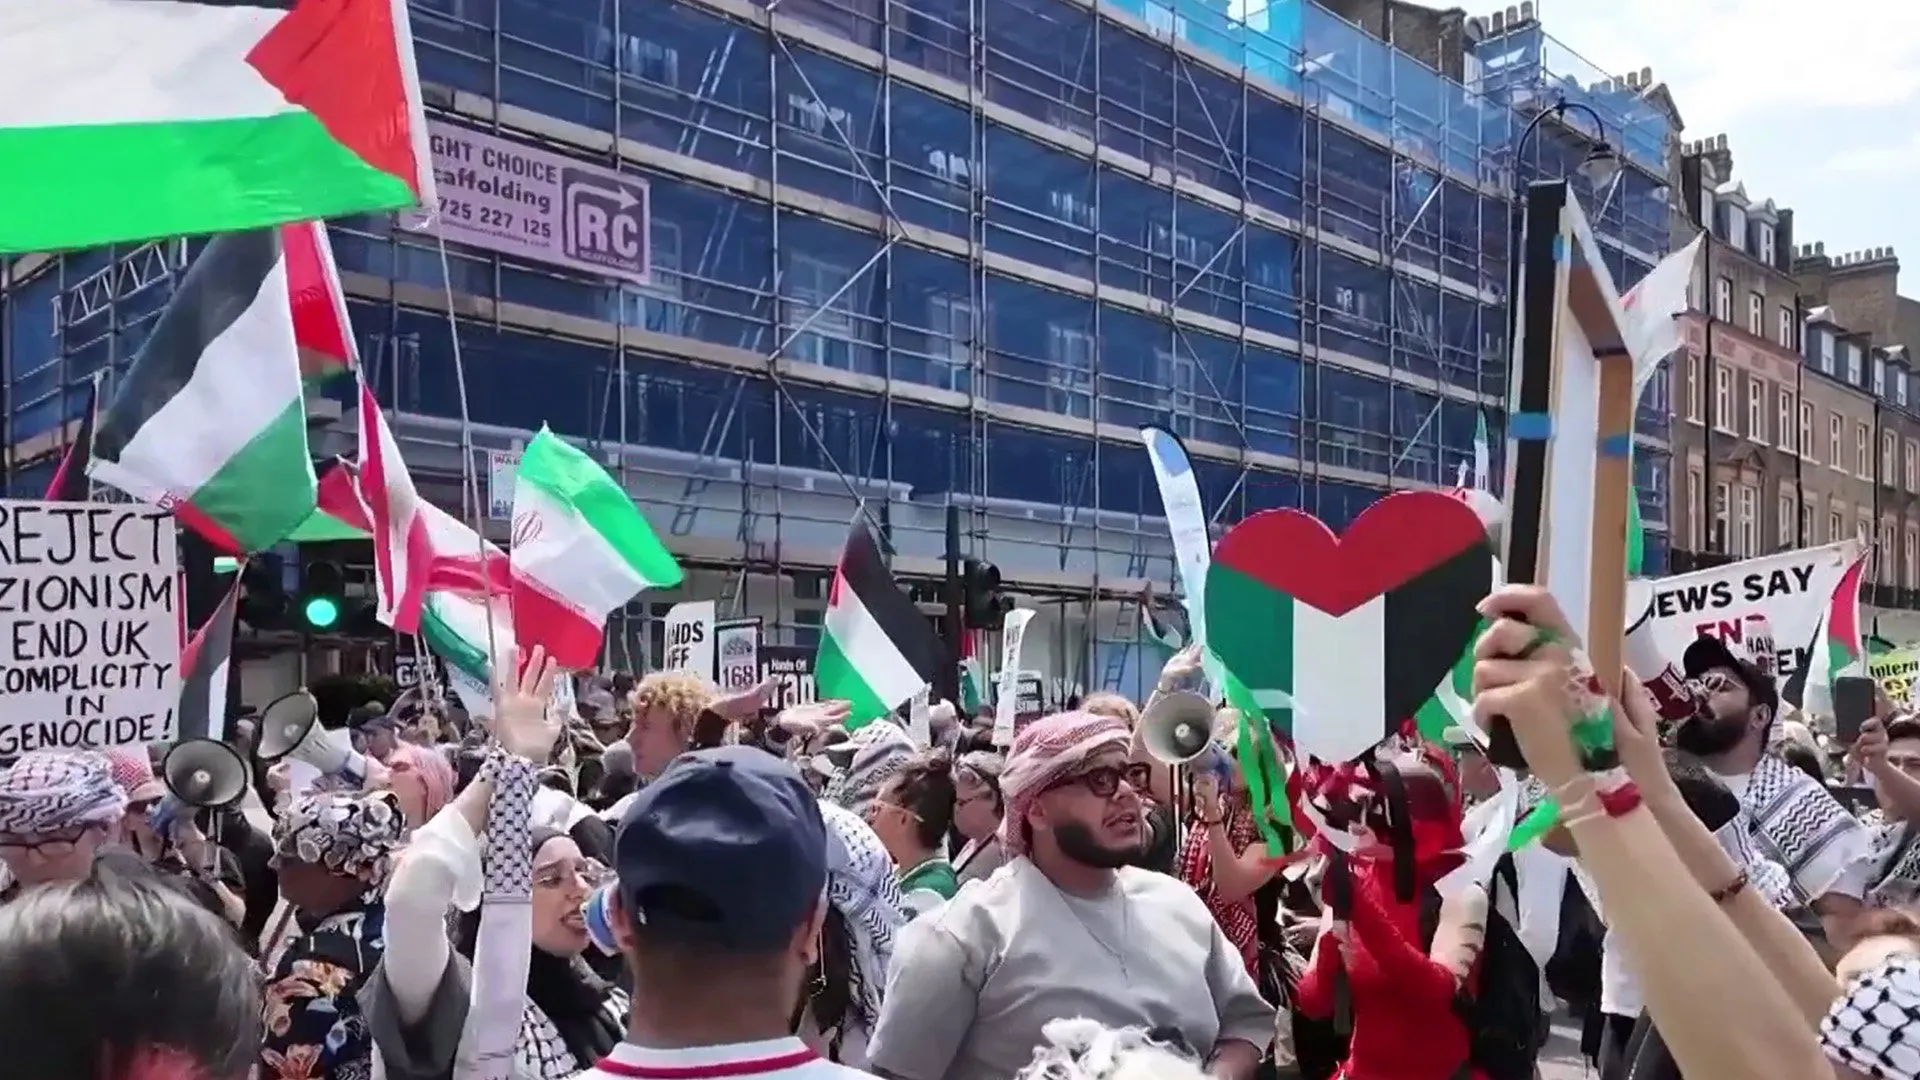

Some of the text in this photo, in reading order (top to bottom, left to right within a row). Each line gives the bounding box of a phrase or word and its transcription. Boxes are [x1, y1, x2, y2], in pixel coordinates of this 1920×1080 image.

[430, 135, 557, 185] GHT CHOICE
[433, 167, 551, 215] caffolding
[437, 196, 472, 220] 725
[480, 207, 513, 229] 227
[523, 218, 551, 239] 125
[578, 203, 638, 259] RC
[0, 572, 172, 613] ZIONISM
[1744, 563, 1815, 601] SAY
[13, 618, 150, 661] END UK
[1696, 613, 1767, 646] EN
[0, 662, 173, 695] OMPLICITY
[723, 665, 755, 689] 168
[65, 694, 105, 716] IN
[0, 708, 173, 755] GENOCIDE!
